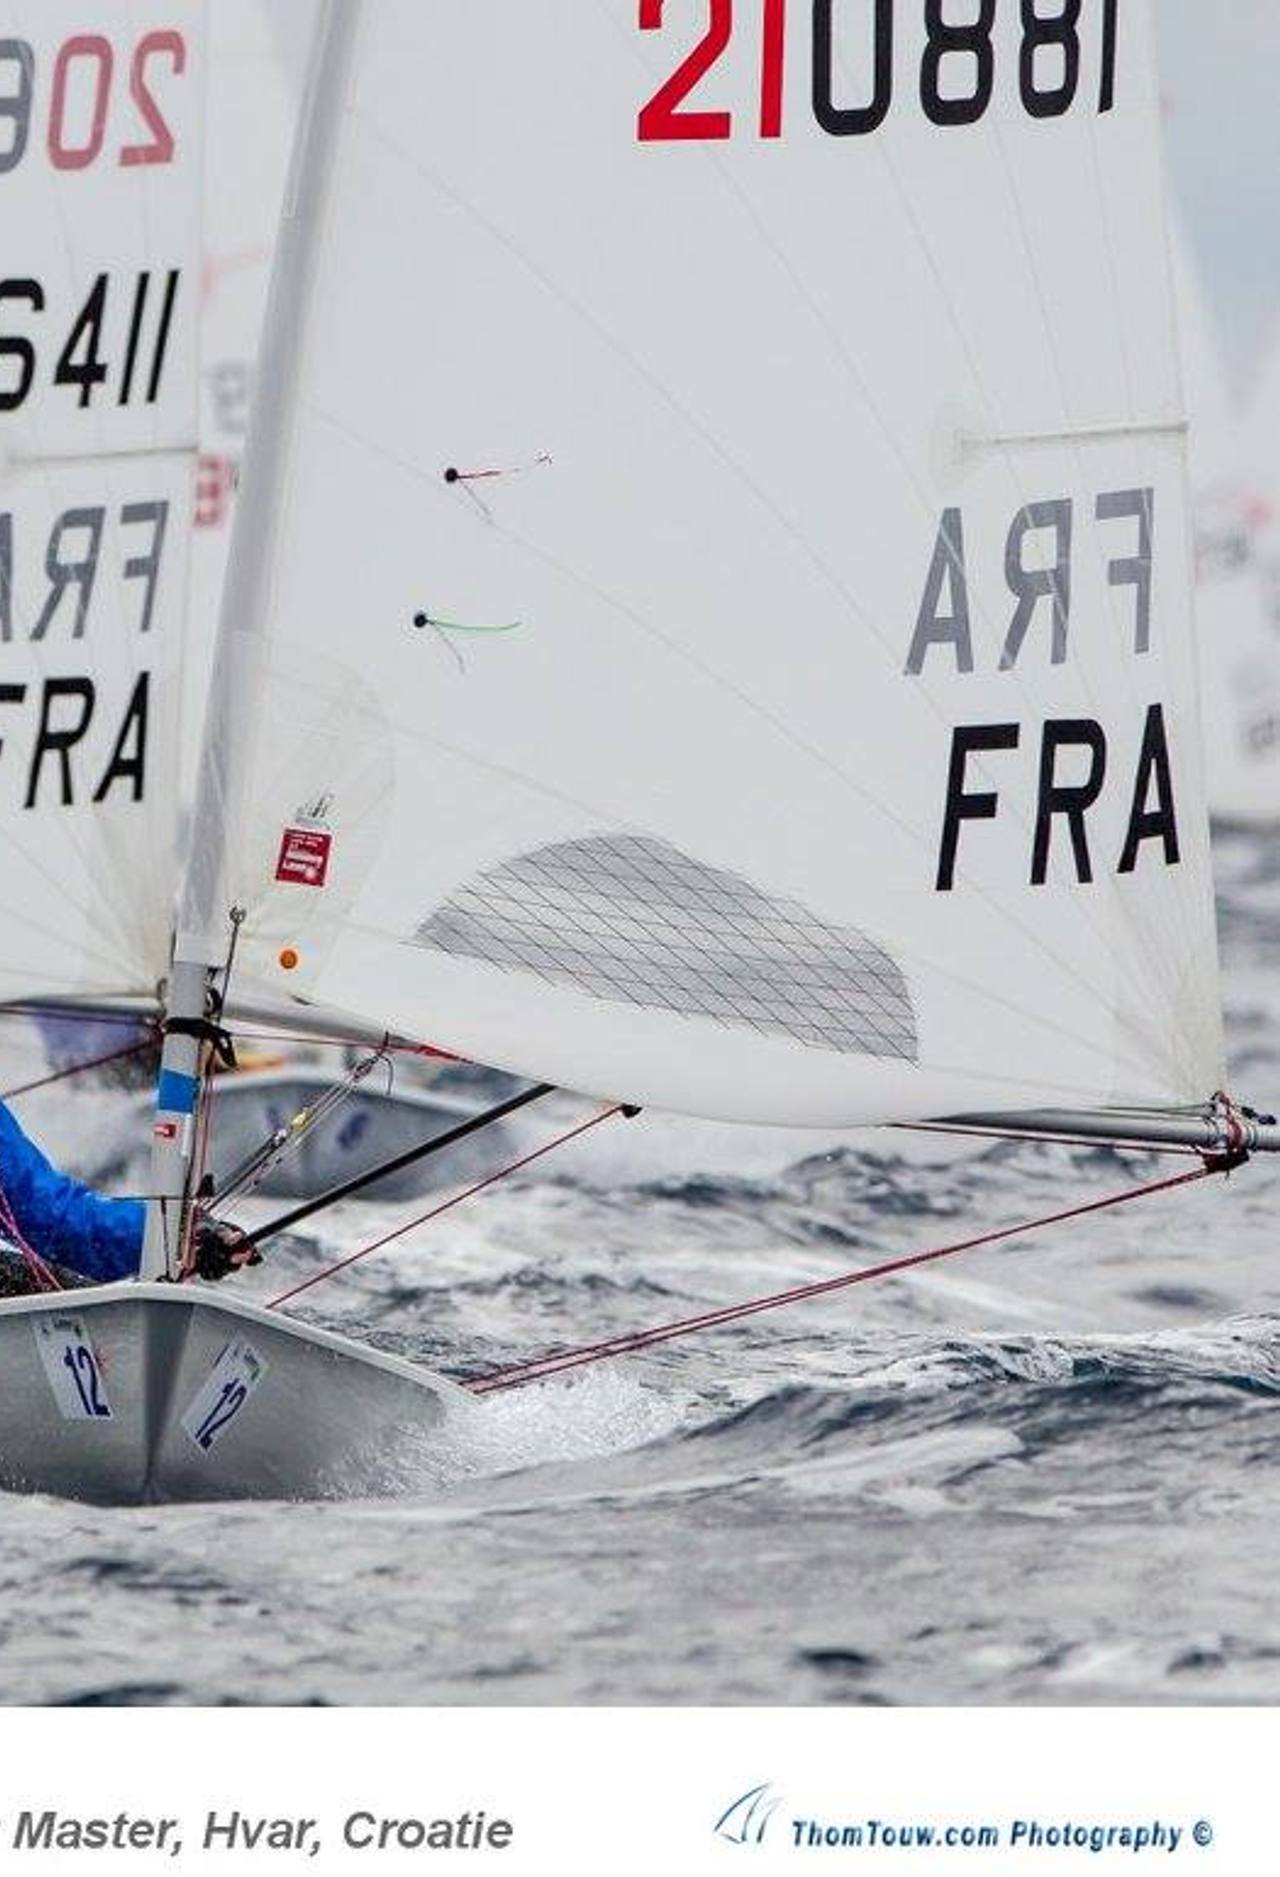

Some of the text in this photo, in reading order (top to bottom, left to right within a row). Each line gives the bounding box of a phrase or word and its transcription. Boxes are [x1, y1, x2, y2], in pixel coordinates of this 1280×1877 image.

[637, 0, 1117, 141] 210881
[936, 703, 1181, 891] FRA
[63, 1345, 111, 1417] 12
[194, 1378, 248, 1450] 12
